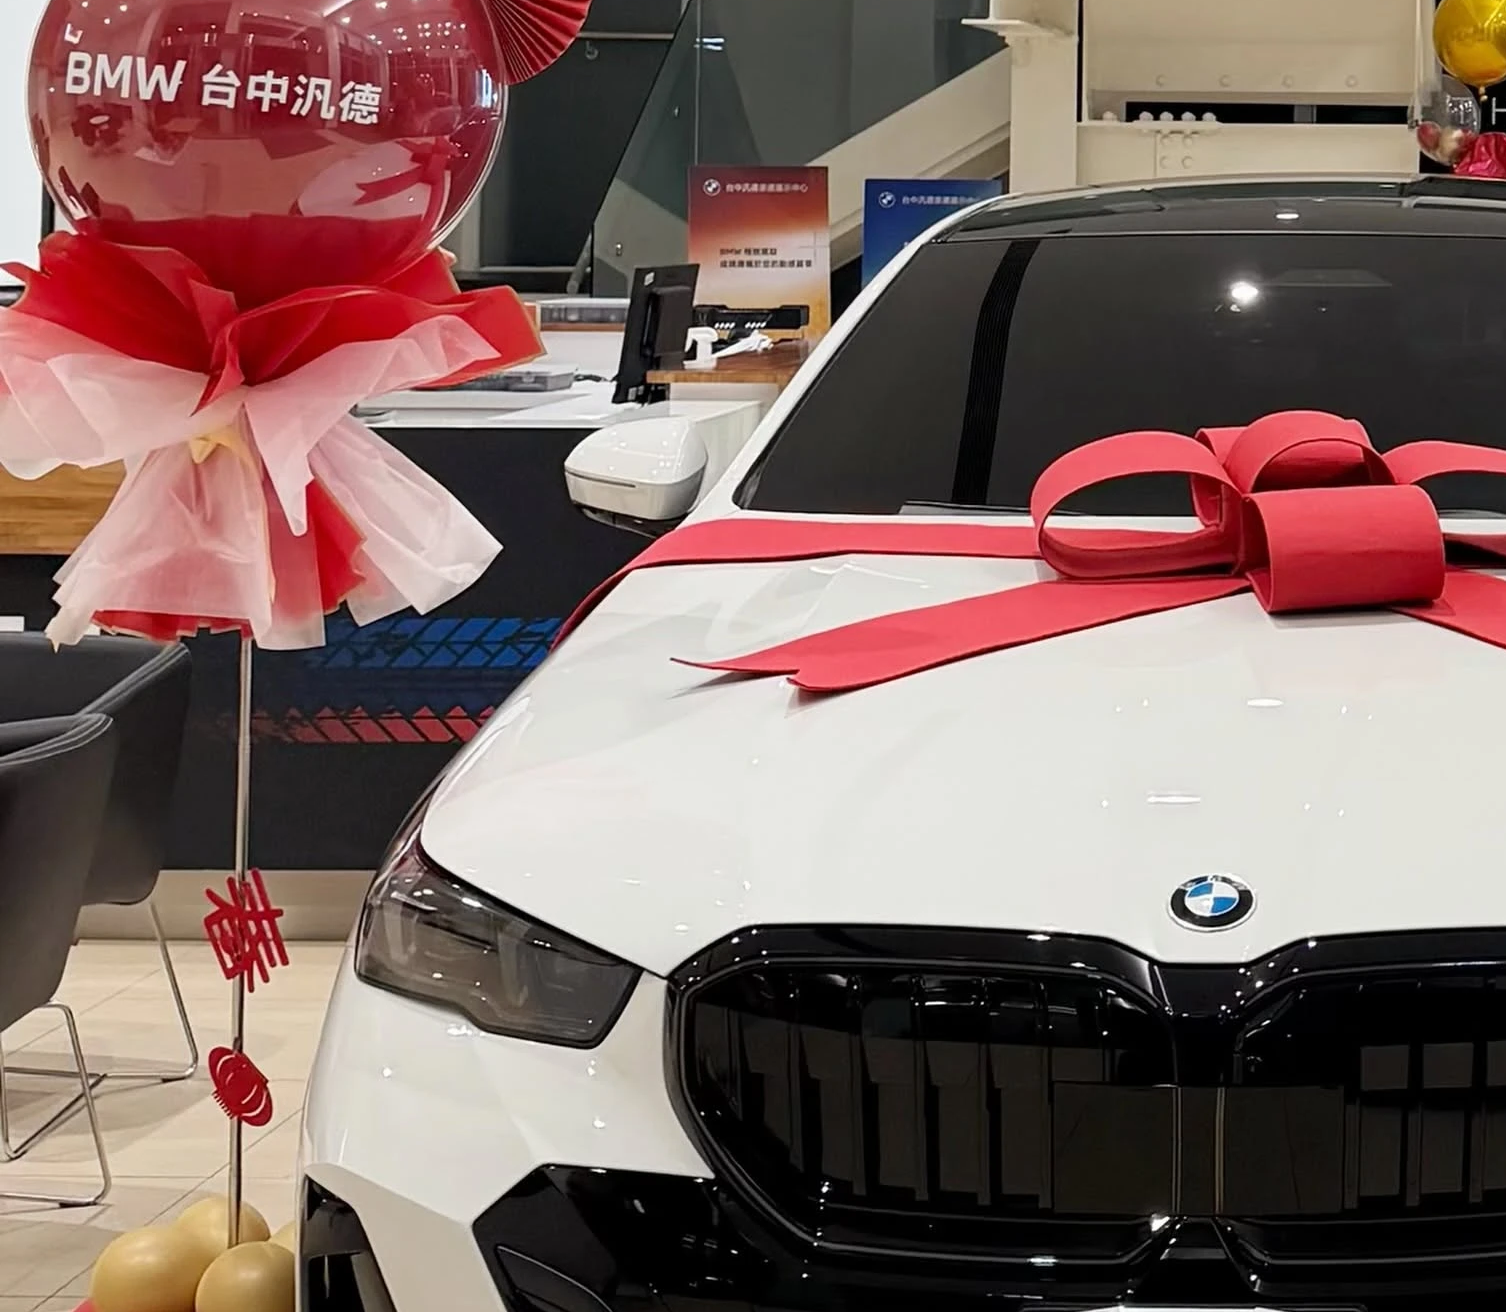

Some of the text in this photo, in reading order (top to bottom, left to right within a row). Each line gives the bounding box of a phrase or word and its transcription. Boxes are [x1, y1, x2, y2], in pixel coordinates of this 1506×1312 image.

[65, 51, 382, 125] BMW 台中汎德
